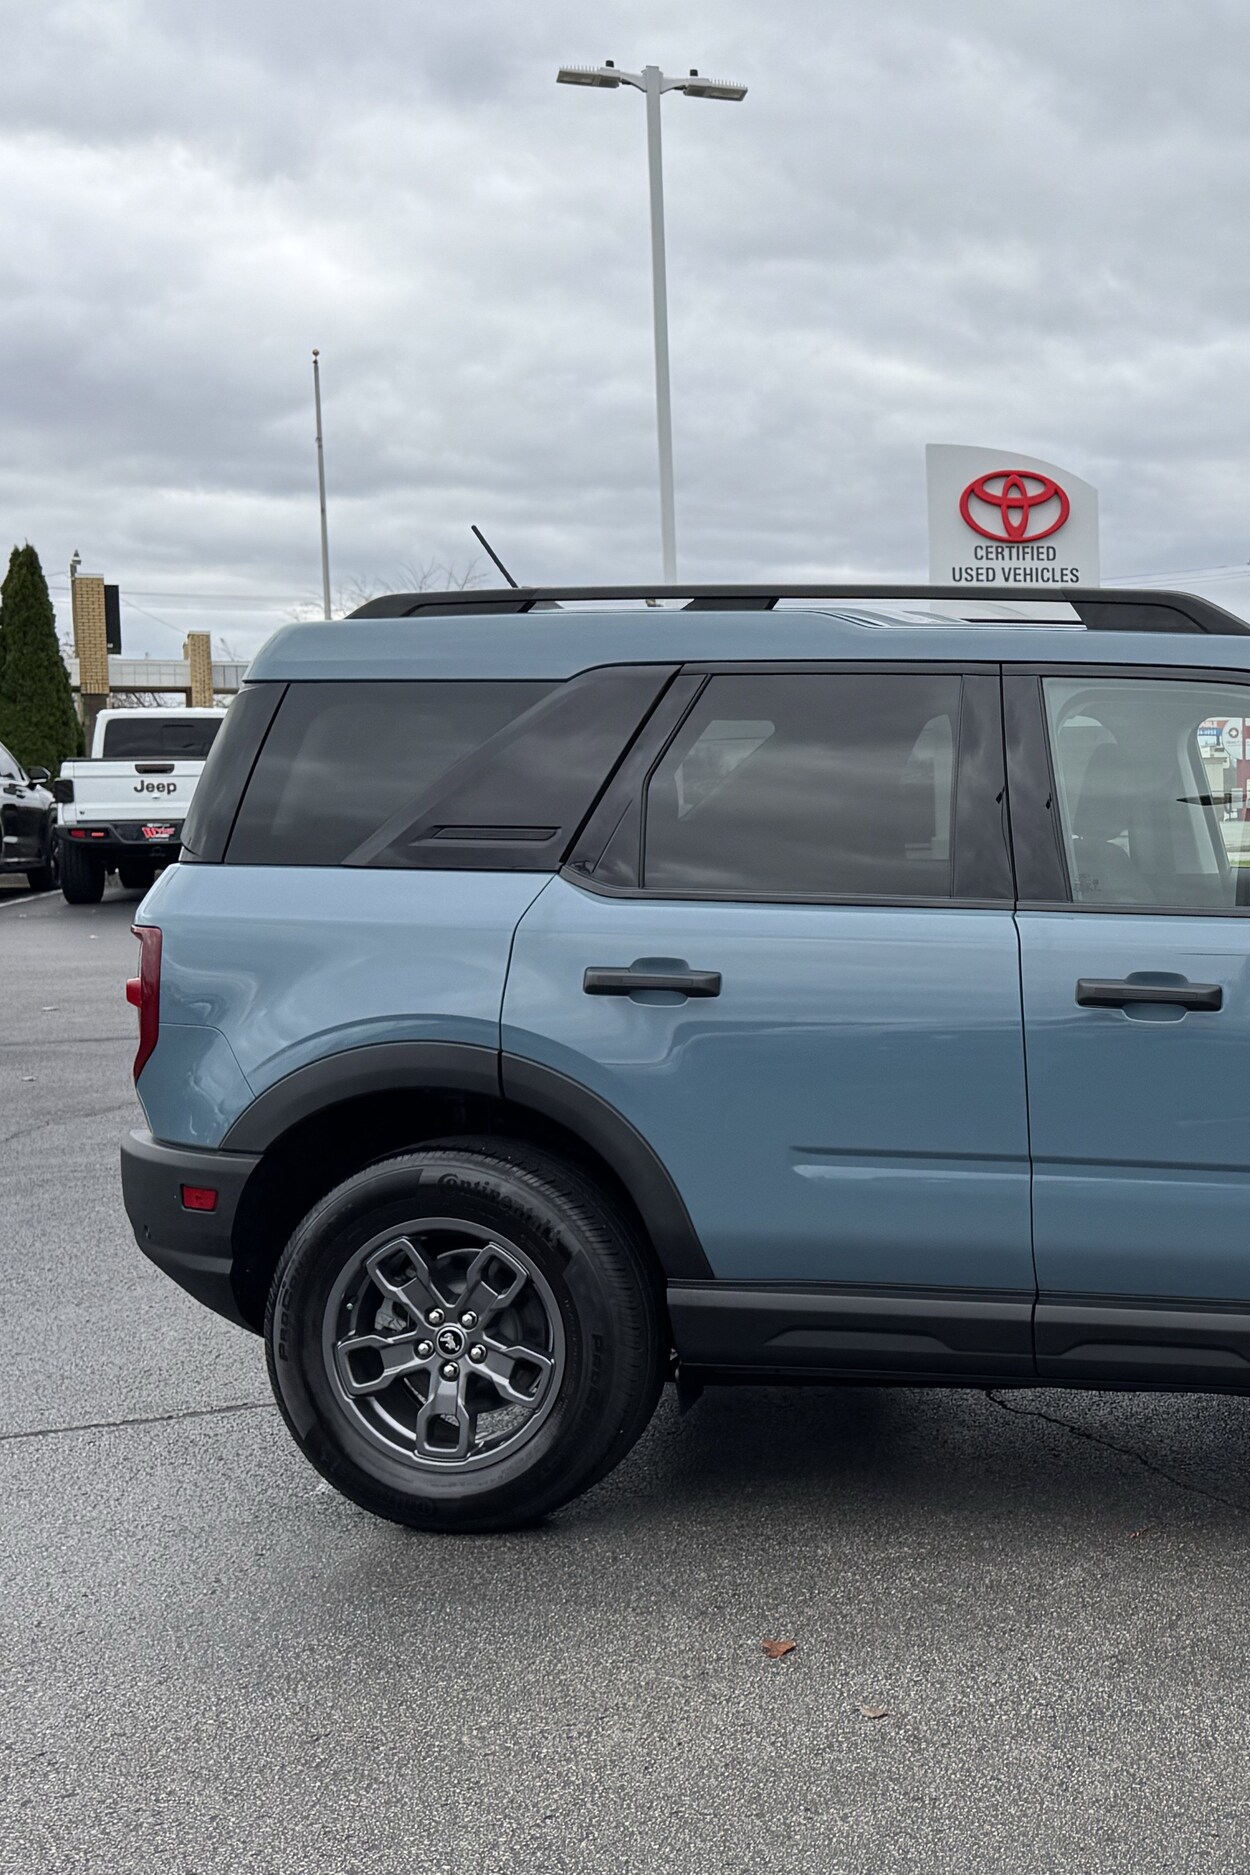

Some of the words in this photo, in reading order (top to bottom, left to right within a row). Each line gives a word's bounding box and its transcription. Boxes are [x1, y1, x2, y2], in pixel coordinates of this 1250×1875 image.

[973, 545, 1057, 561] CERTIFIED
[952, 566, 996, 582] USED
[1001, 567, 1080, 583] VEHICLES
[133, 780, 177, 795] Jeep
